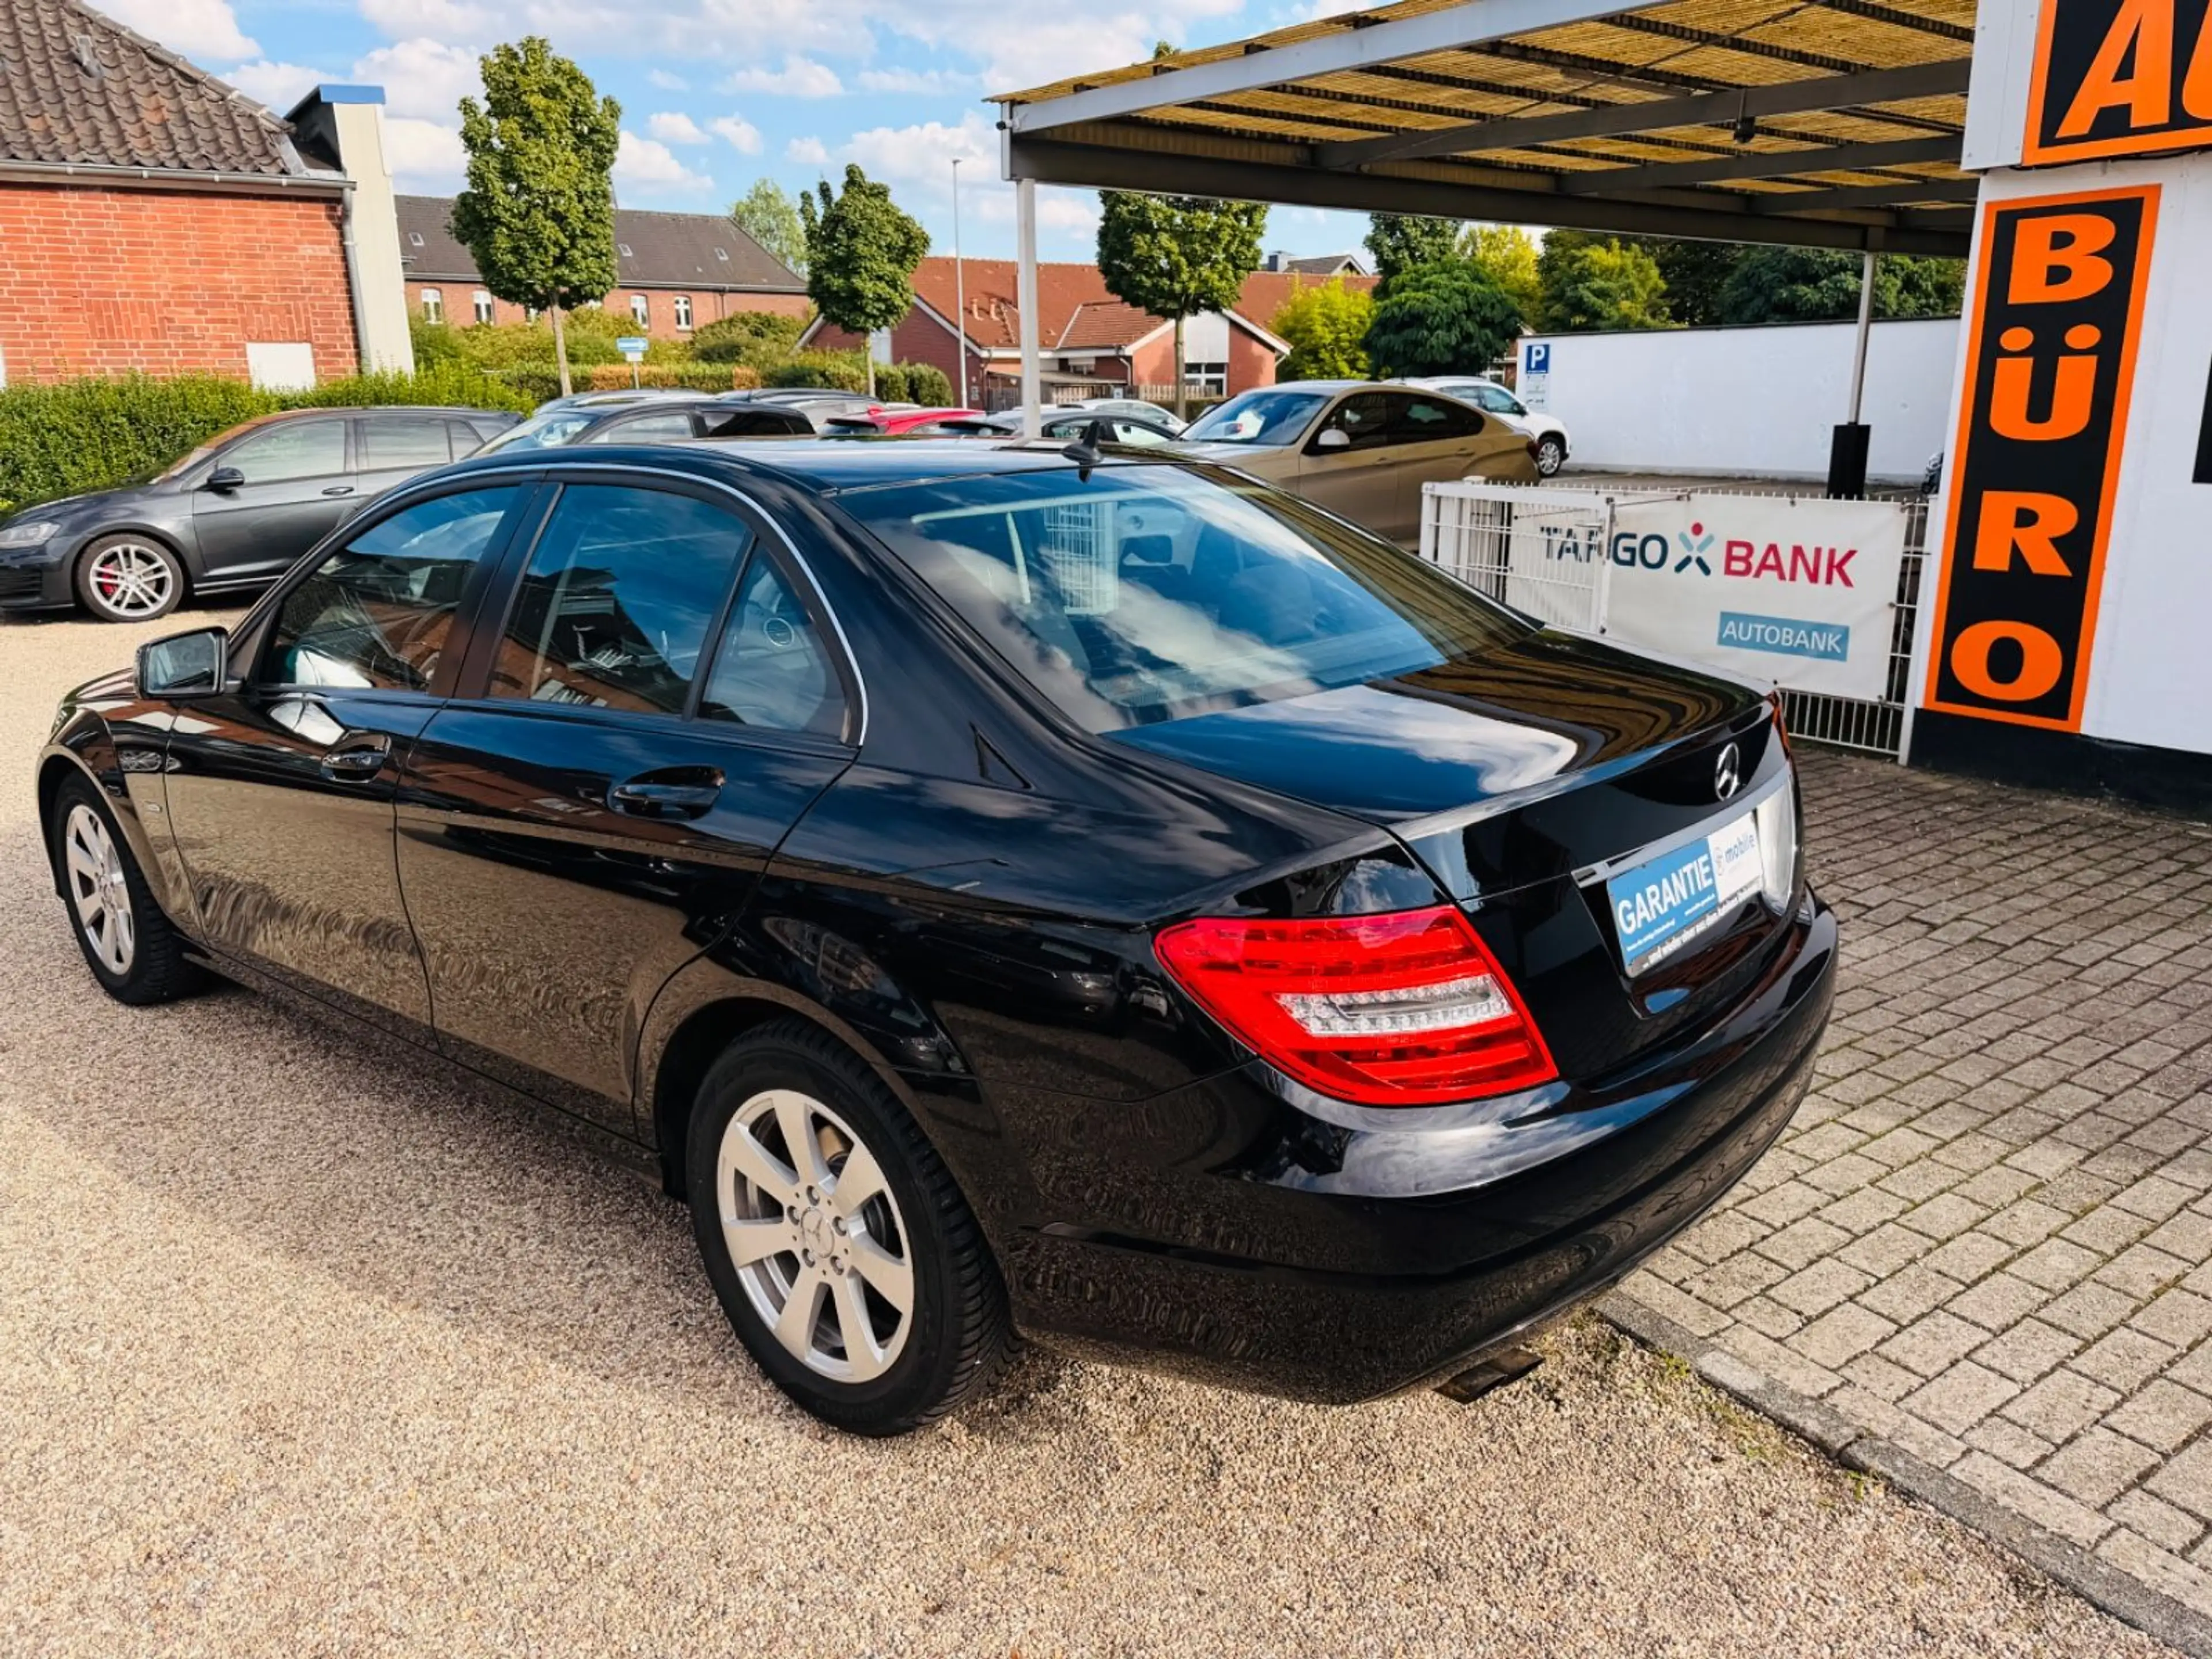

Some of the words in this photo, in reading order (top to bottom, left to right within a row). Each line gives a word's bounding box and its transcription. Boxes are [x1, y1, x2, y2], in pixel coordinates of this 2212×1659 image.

[2055, 0, 2212, 139] A
[1531, 345, 1546, 369] P
[1951, 213, 2116, 701] BÜRO
[1724, 540, 1858, 589] BANK
[1722, 620, 1843, 654] AUTOBANK
[1617, 854, 1714, 935] GARANTIE
